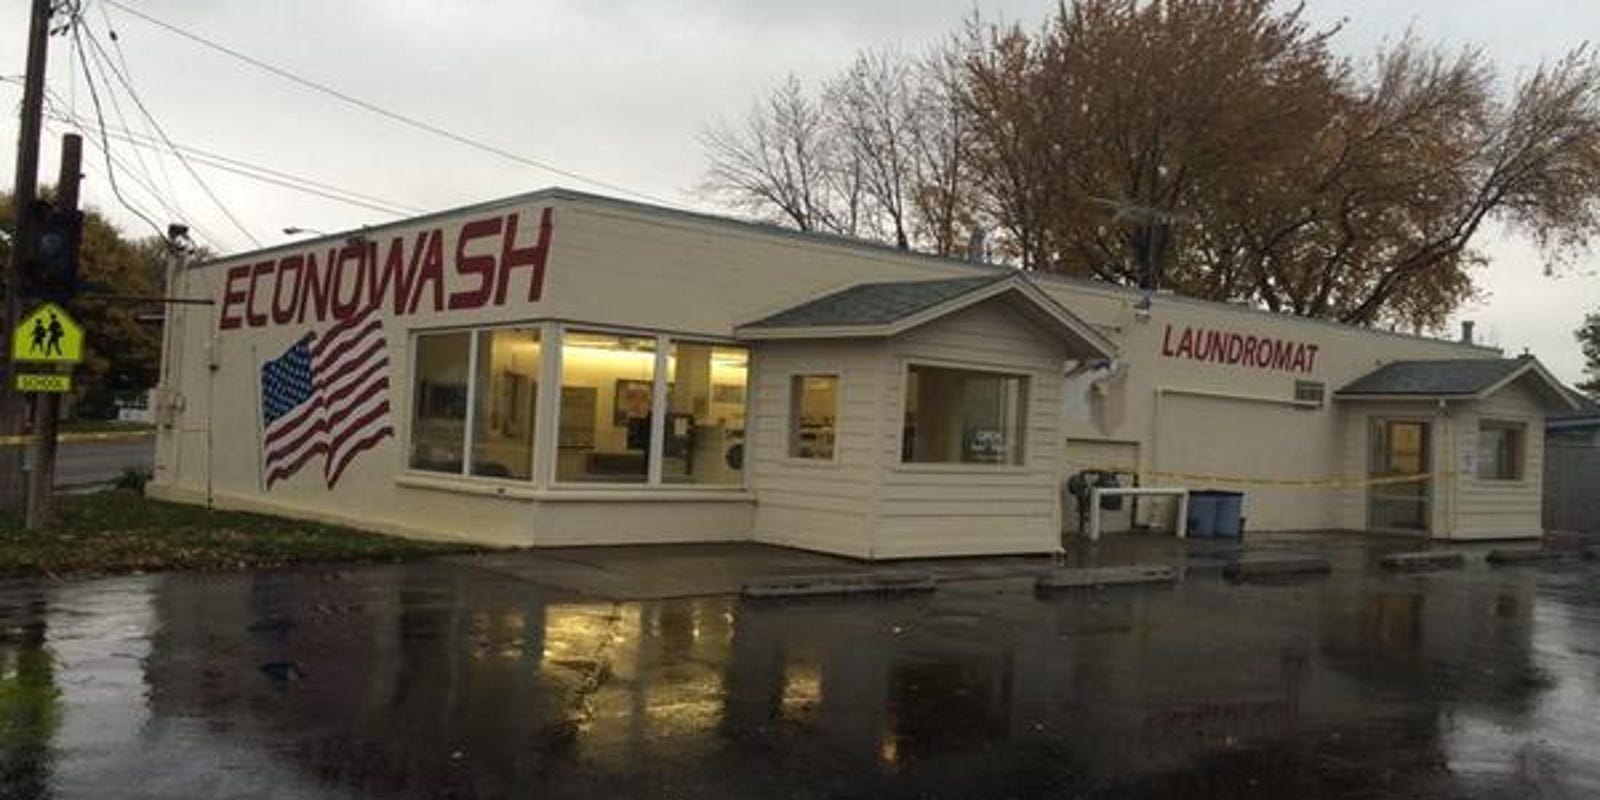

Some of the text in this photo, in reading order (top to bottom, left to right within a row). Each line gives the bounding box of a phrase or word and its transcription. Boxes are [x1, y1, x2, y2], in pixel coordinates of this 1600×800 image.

[219, 207, 553, 331] ECONOWASH
[1162, 324, 1319, 373] LAUNDROMAT
[23, 376, 63, 389] SCHOOL
